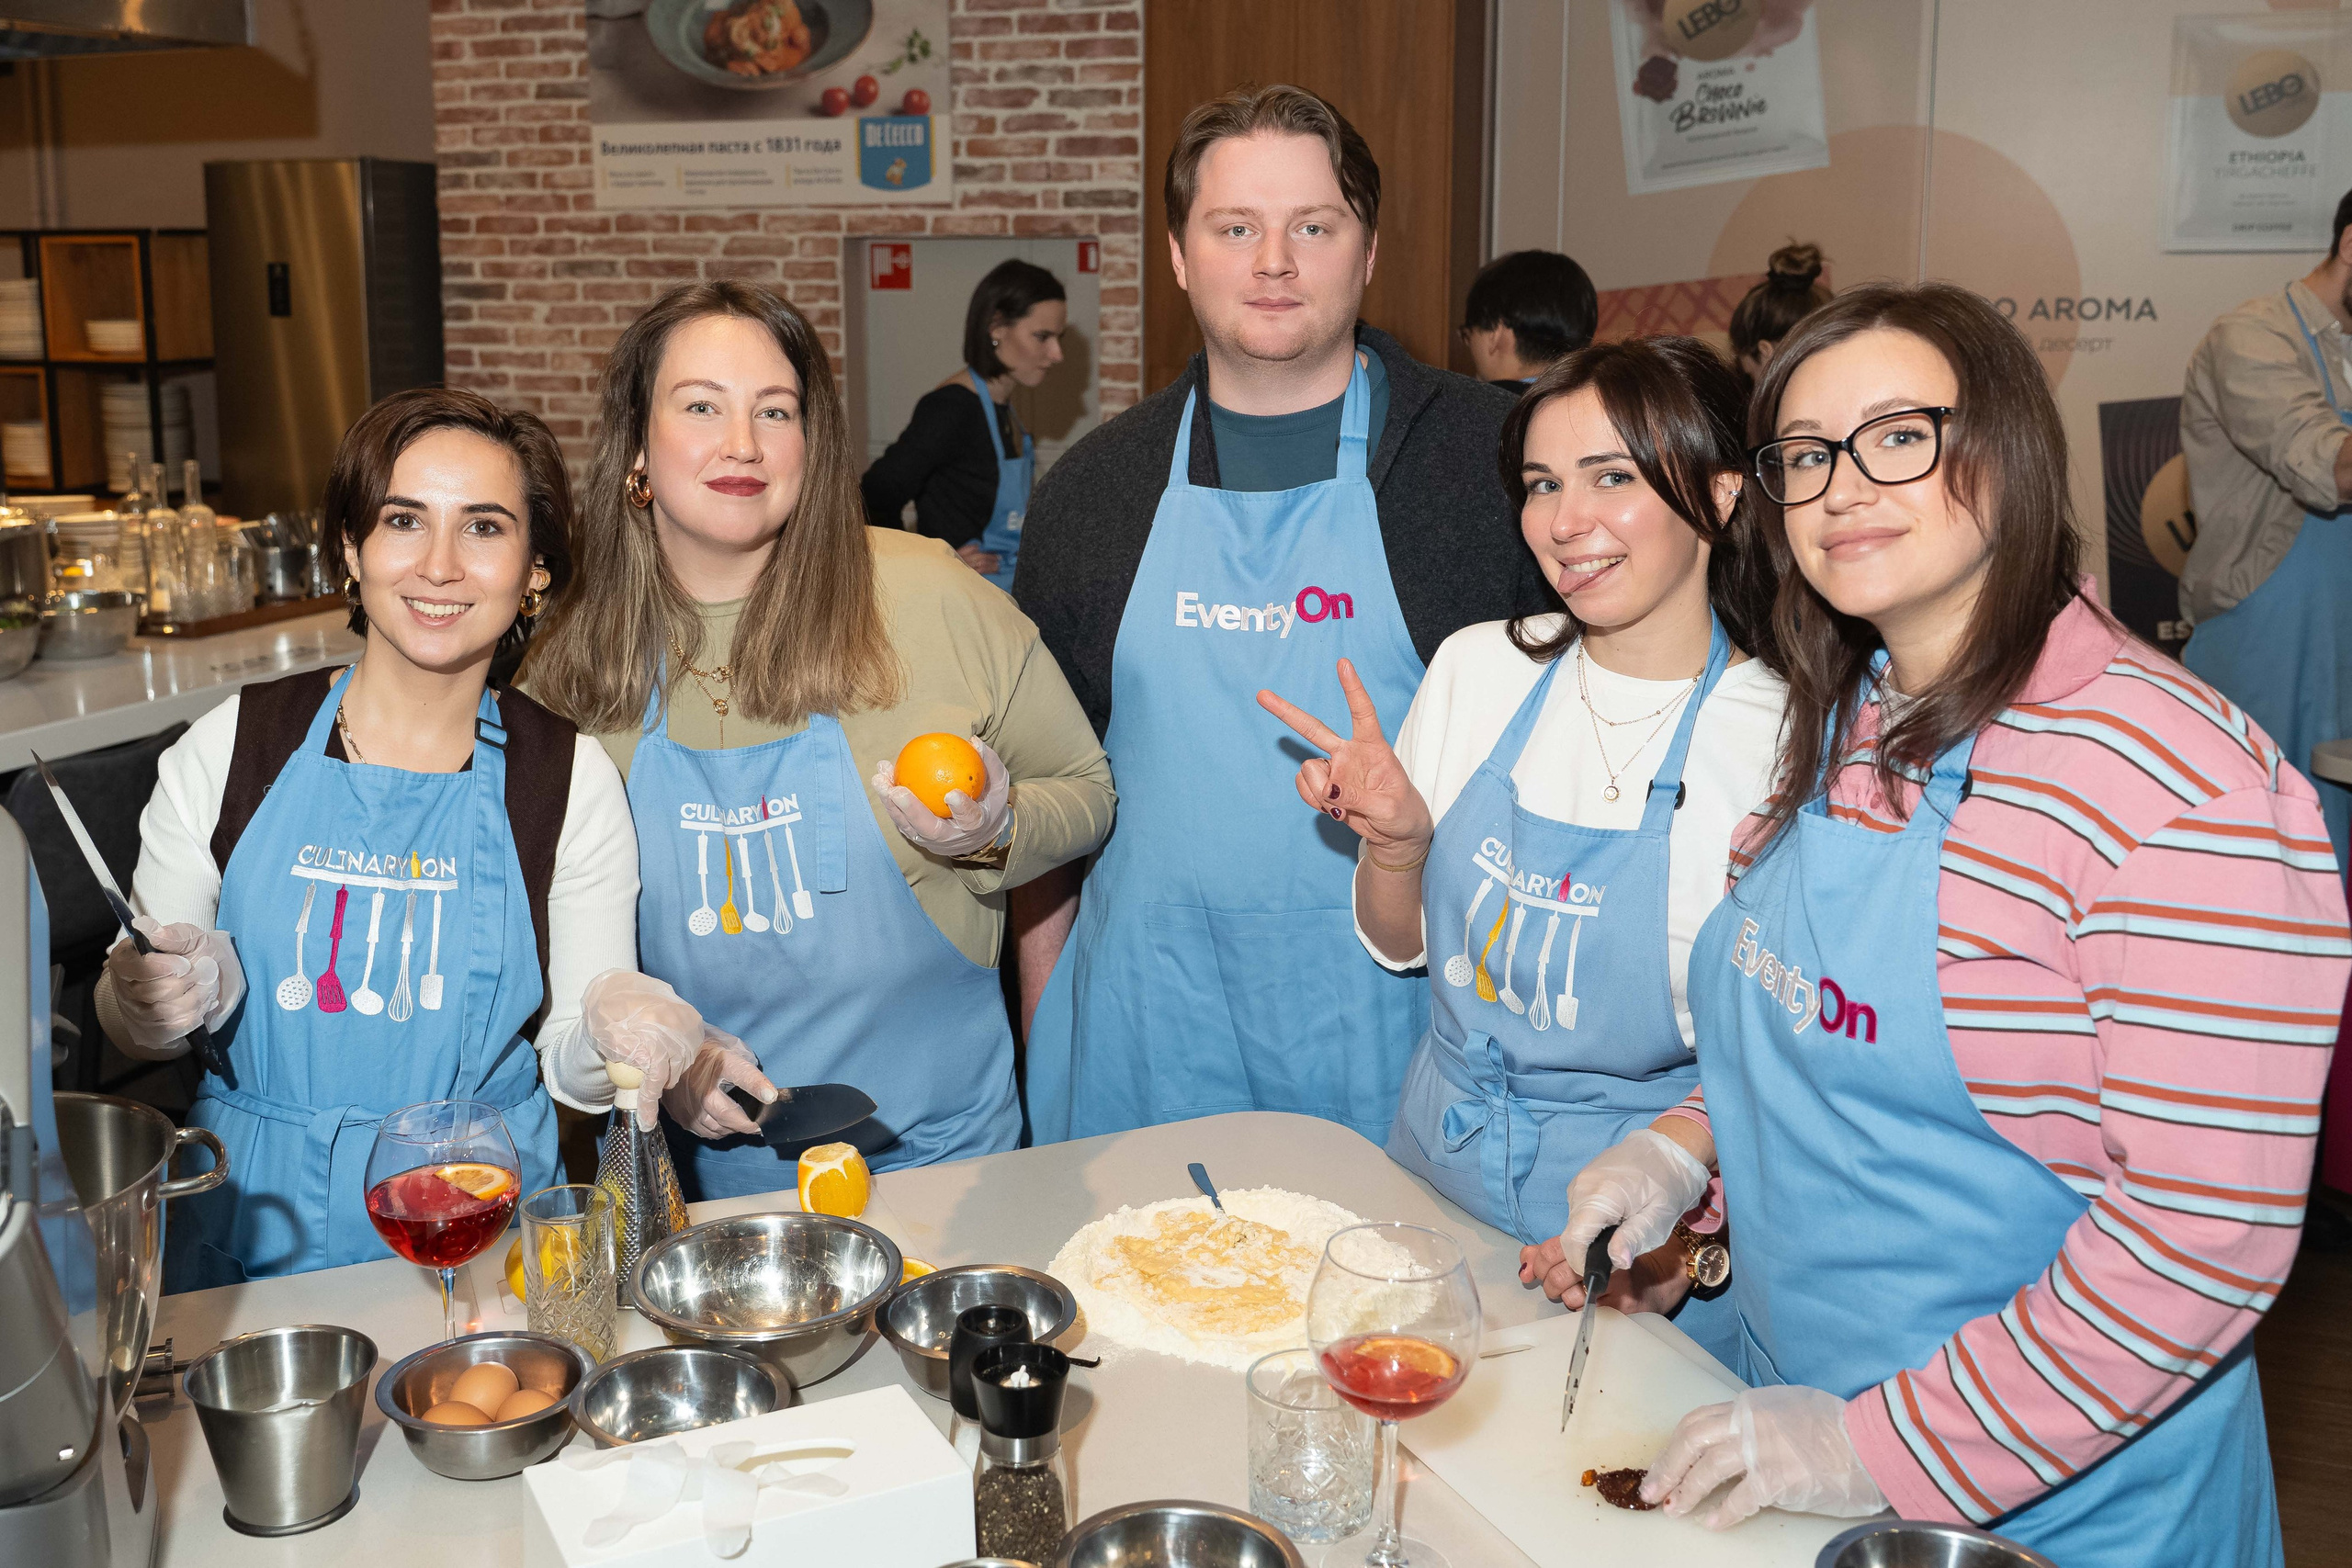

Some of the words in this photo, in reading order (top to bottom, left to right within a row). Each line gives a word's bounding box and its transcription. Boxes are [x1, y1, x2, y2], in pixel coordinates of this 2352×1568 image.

[2238, 73, 2304, 116] LEBO
[600, 140, 705, 157] Великолепная
[708, 141, 750, 154] паста
[753, 141, 763, 153] с
[766, 136, 802, 153] 1831
[805, 138, 842, 154] года
[2228, 150, 2306, 164] ETHIOPIA
[2028, 297, 2158, 321] AROMA
